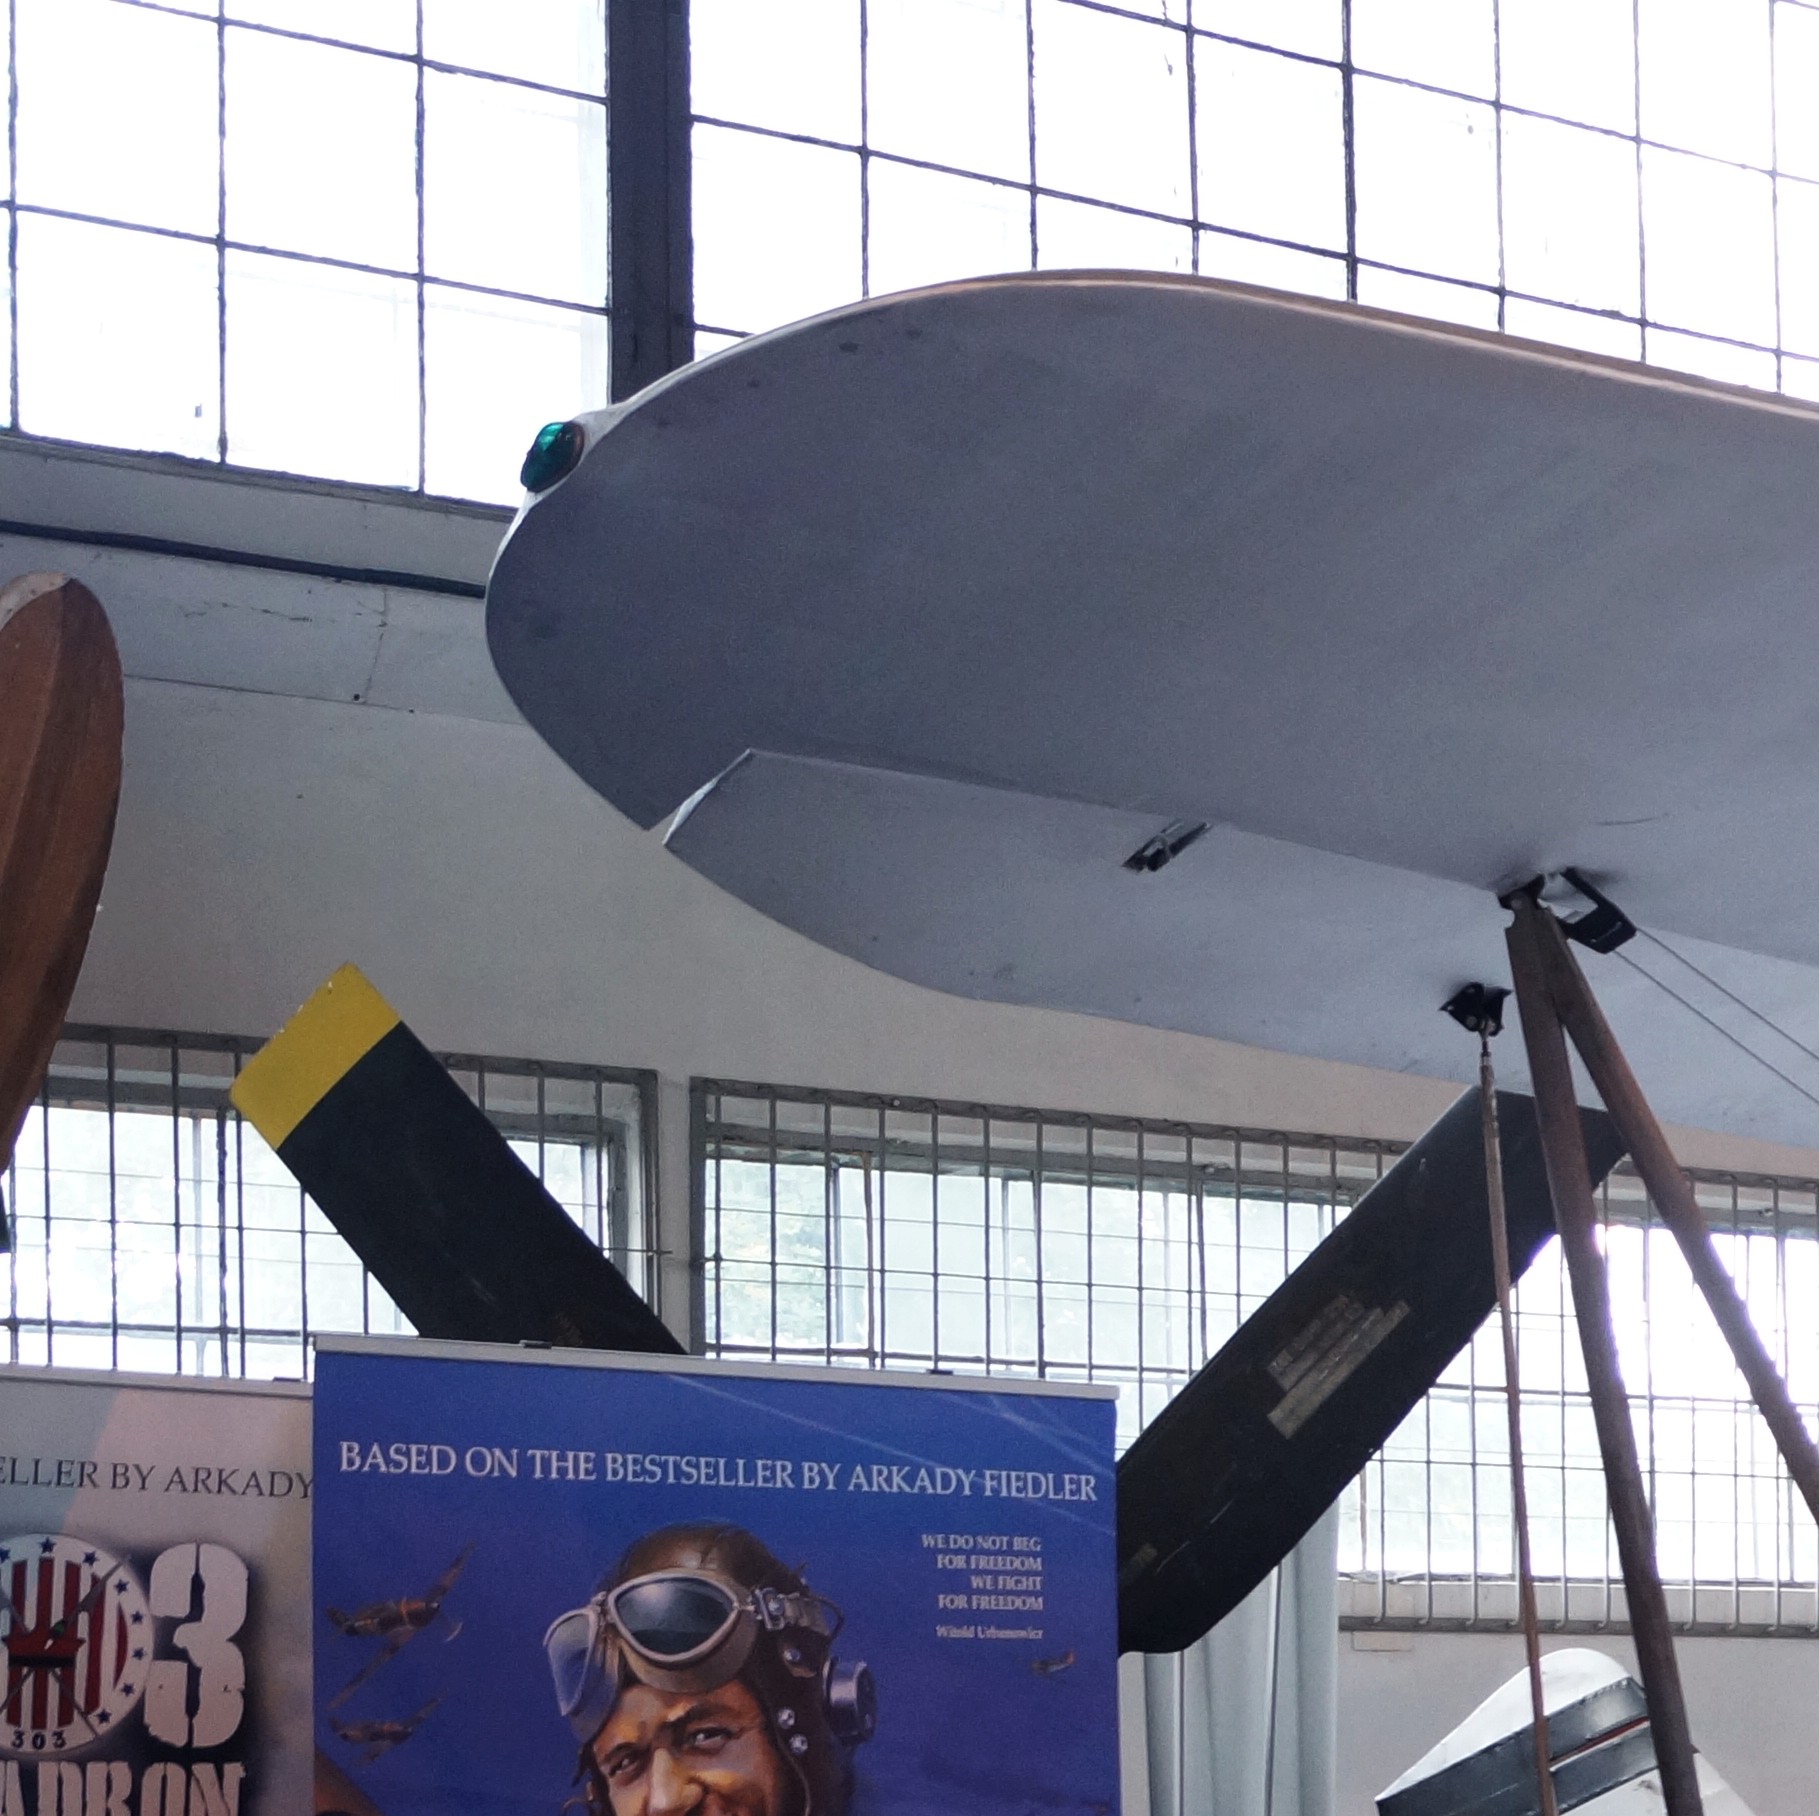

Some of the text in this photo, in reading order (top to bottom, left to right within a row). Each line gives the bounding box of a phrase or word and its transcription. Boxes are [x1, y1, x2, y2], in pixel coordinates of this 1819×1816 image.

[0, 1456, 313, 1500] LLER BY ARKADY
[339, 1440, 1099, 1502] BASED ON THE BESTSELLER BY ARKADY FIEDLER
[920, 1533, 1042, 1552] WE DO NOT BEG
[936, 1553, 1043, 1572] FOR FREEDOM
[970, 1574, 1044, 1591] WE FIGHT
[937, 1593, 1044, 1611] FOR FREEDOM
[12, 1730, 67, 1749] 303
